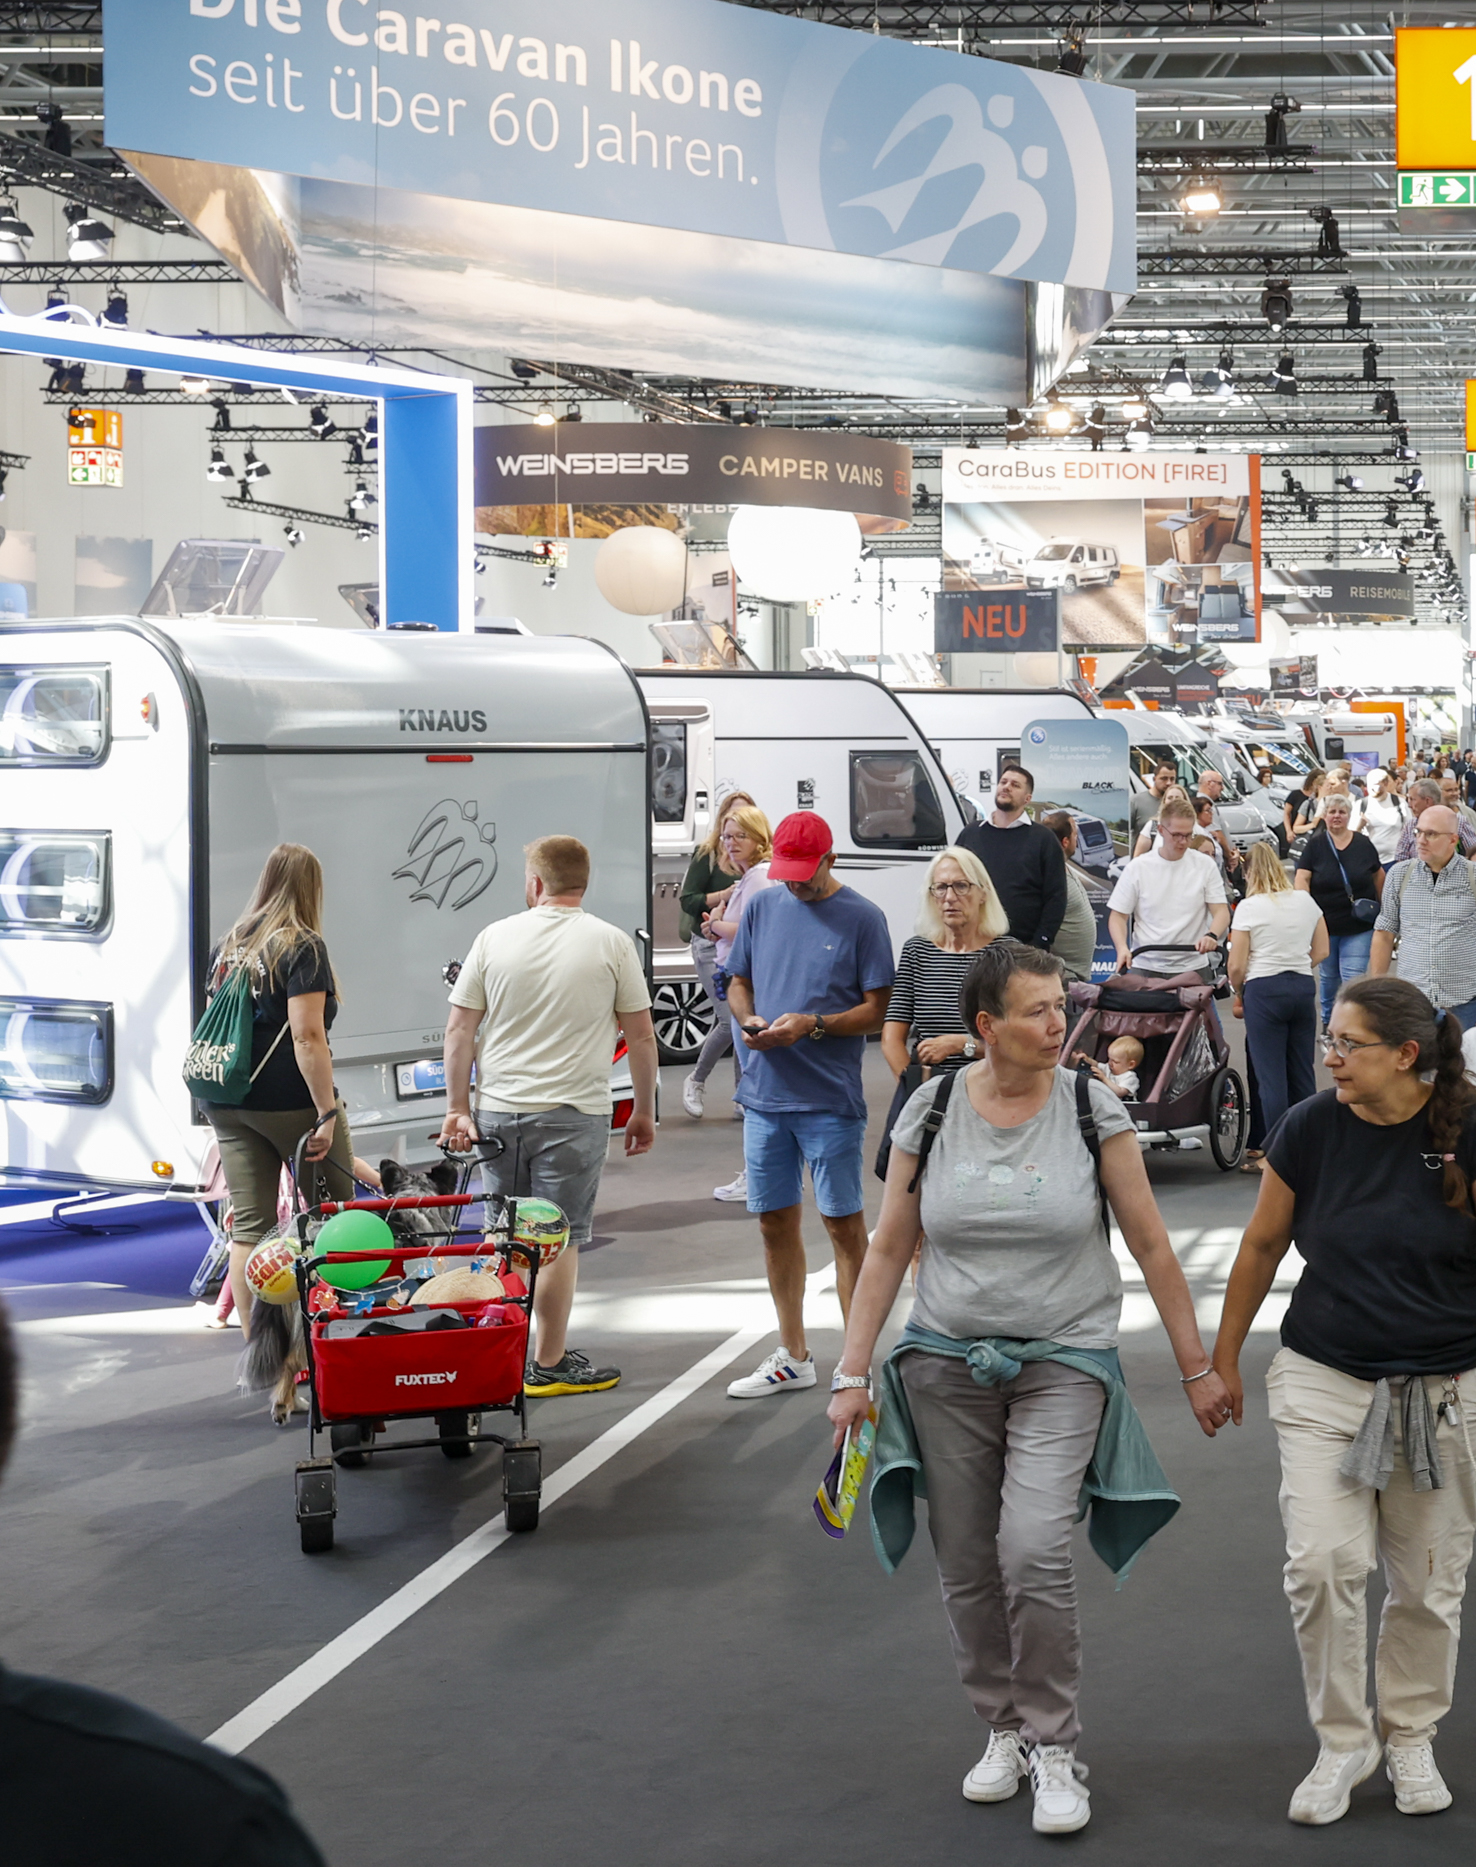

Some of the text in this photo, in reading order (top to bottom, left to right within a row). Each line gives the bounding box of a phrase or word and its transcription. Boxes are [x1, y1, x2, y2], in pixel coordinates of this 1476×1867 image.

[326, 0, 588, 87] Caravan
[610, 38, 763, 118] Ikone
[188, 52, 759, 186] seit über 60 Jahren.
[496, 452, 884, 488] WEINSBERG CAMPER VANS
[957, 459, 1228, 484] CaraBus EDITION [FIRE]
[1350, 586, 1411, 601] REISEMOBILE
[962, 604, 1027, 638] NEU
[1172, 623, 1240, 632] WEINSBERG
[399, 708, 488, 733] KNAUS
[1048, 753, 1065, 761] Alles
[1082, 781, 1115, 789] BLACK
[1090, 961, 1118, 973] NAU
[395, 1372, 446, 1387] FUXTEC
